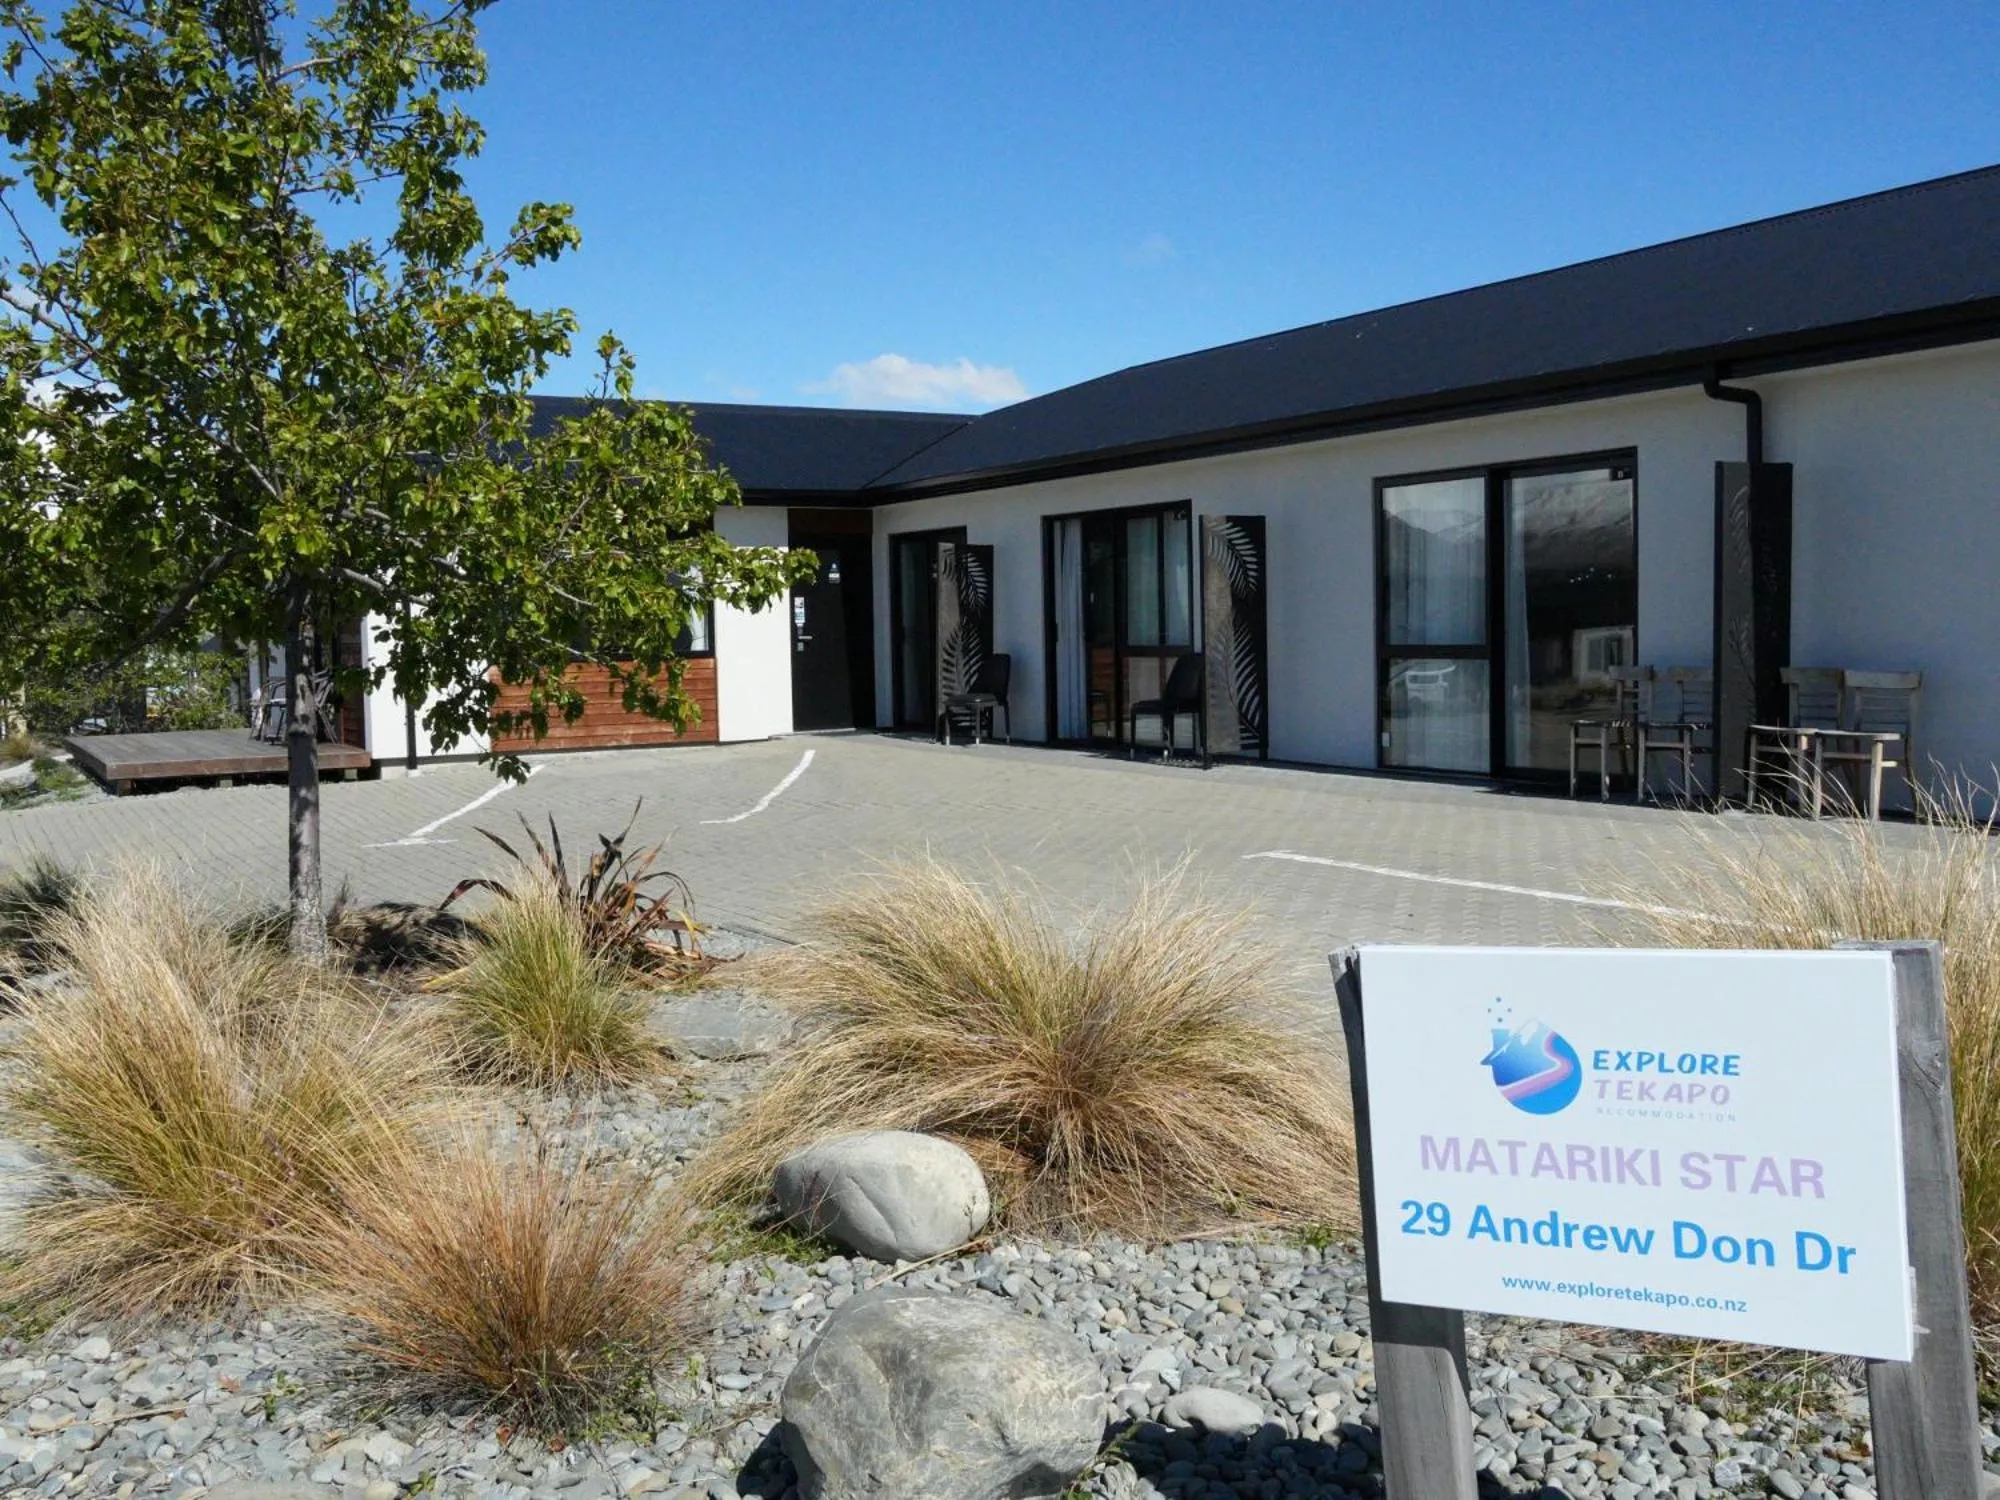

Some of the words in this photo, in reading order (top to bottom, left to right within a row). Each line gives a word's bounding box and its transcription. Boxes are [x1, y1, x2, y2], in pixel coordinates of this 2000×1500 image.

[1593, 1049, 1741, 1076] EXPLORE
[1594, 1079, 1731, 1106] TEKAPO
[1420, 1134, 1662, 1187] MATARIKI
[1680, 1151, 1826, 1199] STAR
[1400, 1199, 1452, 1237] 29
[1467, 1204, 1656, 1256] Andrew
[1672, 1220, 1776, 1267] Don
[1795, 1231, 1857, 1275] Dr
[1502, 1275, 1747, 1313] www.exploretekapo.co.nz
